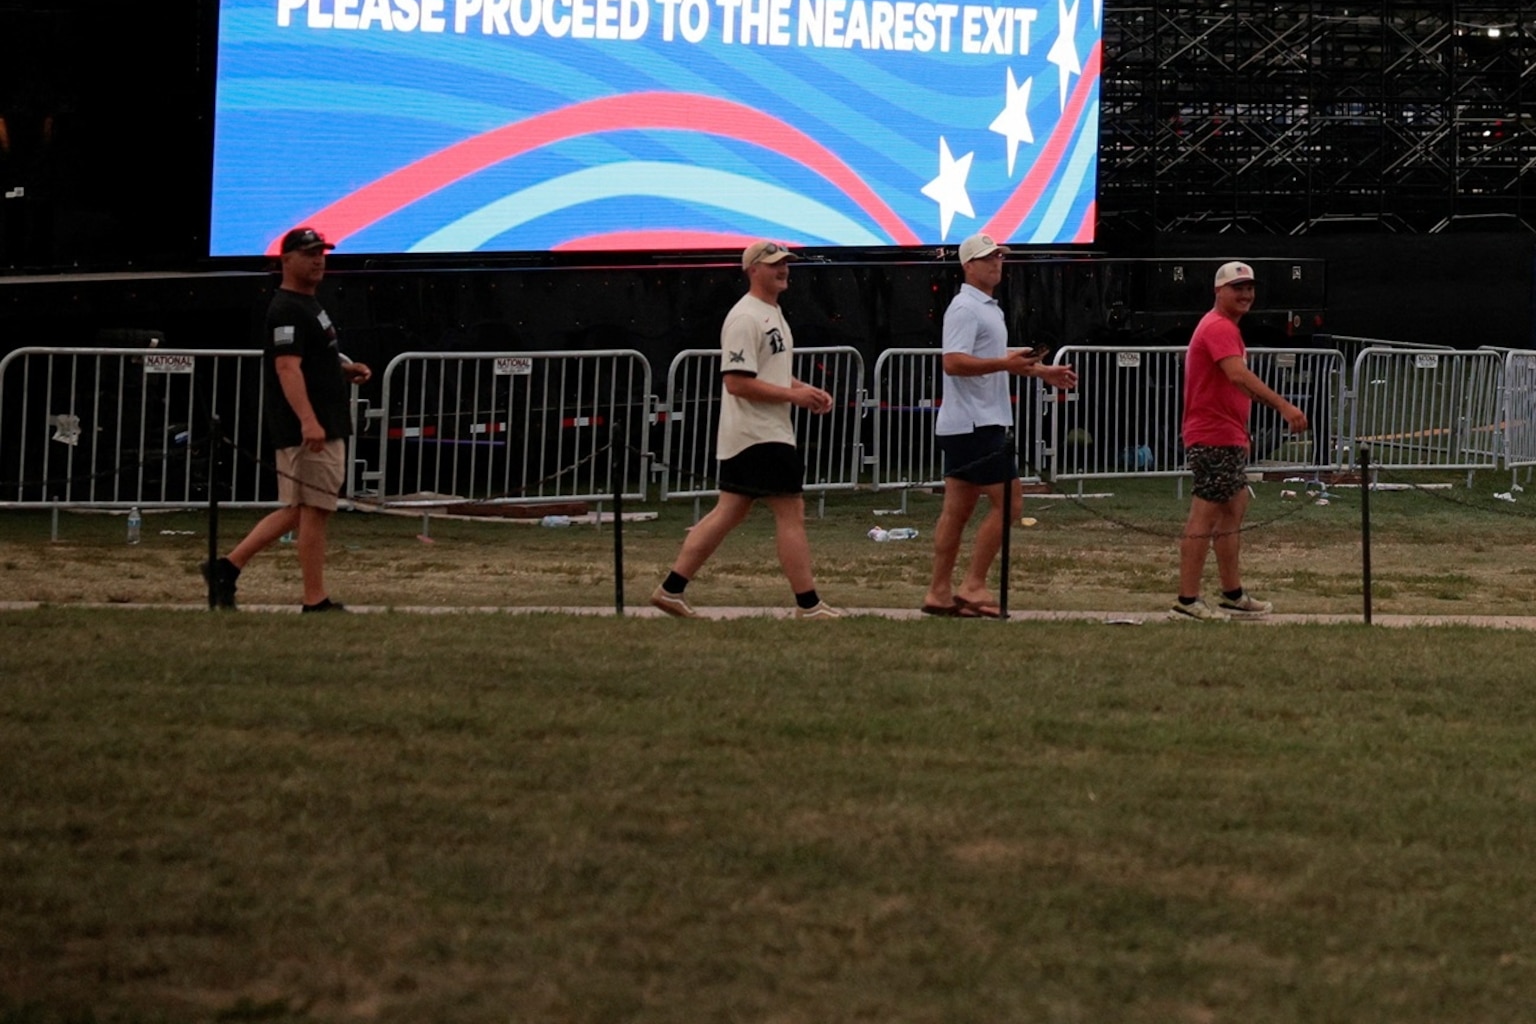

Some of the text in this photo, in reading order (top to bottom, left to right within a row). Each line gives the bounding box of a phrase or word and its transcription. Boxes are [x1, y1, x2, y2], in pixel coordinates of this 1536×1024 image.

[962, 5, 1038, 56] EXIT
[147, 355, 193, 367] NATIONAL
[497, 357, 530, 368] NATIONAL
